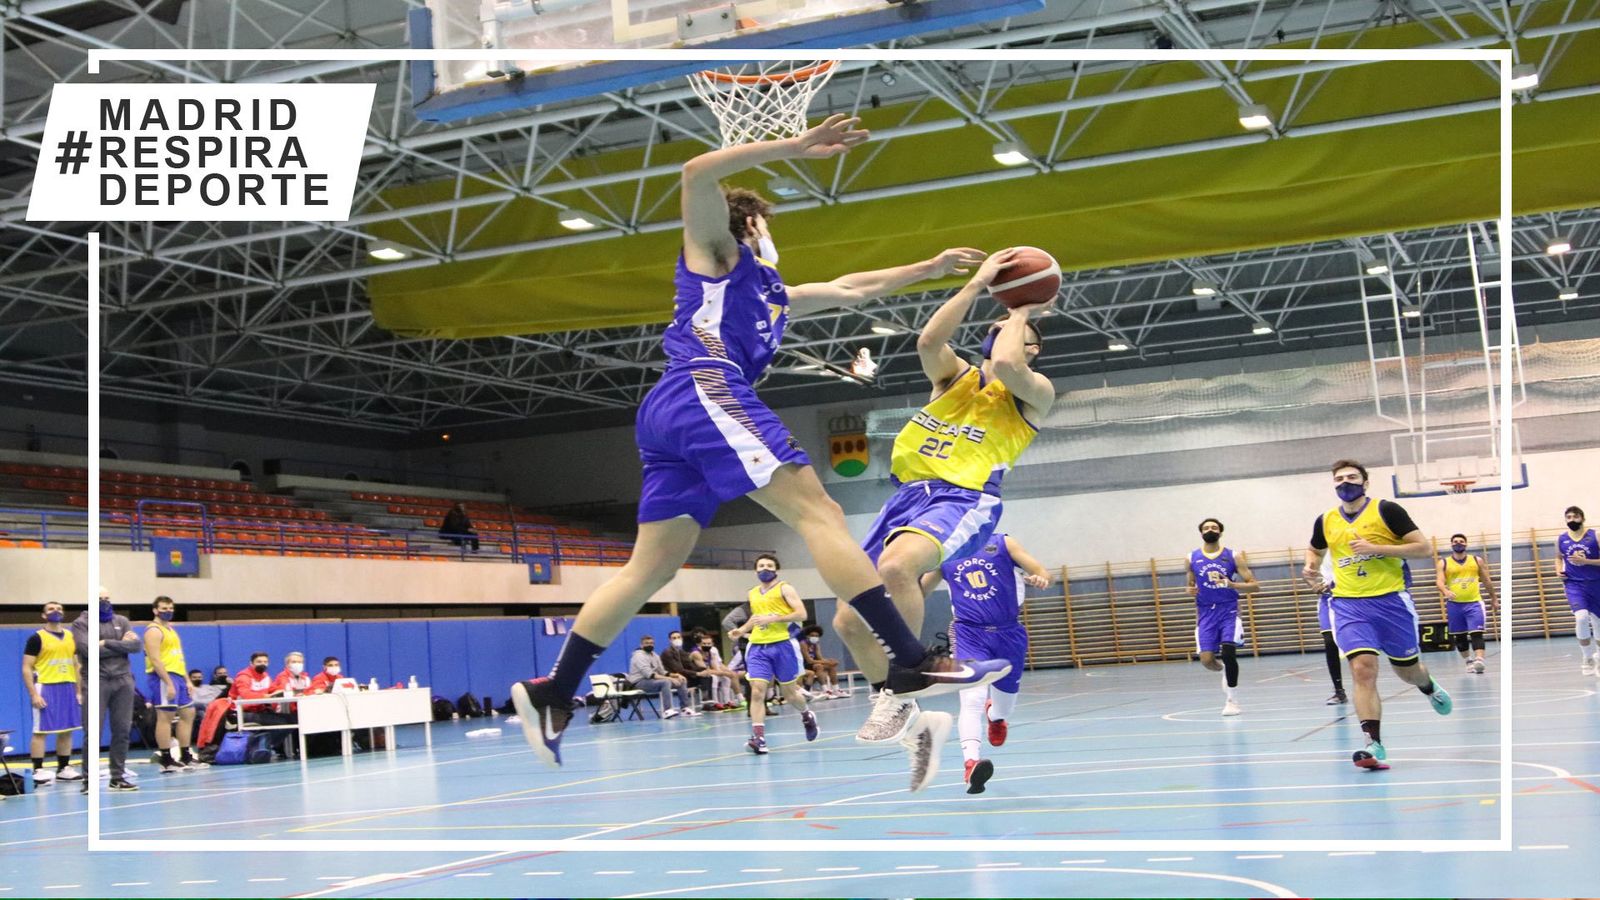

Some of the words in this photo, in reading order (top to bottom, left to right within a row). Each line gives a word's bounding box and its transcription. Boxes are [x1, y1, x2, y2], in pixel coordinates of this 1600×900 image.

[966, 570, 988, 589] 10
[1357, 566, 1368, 577] 4
[963, 585, 999, 601] BASKET
[1422, 626, 1449, 643] 21
